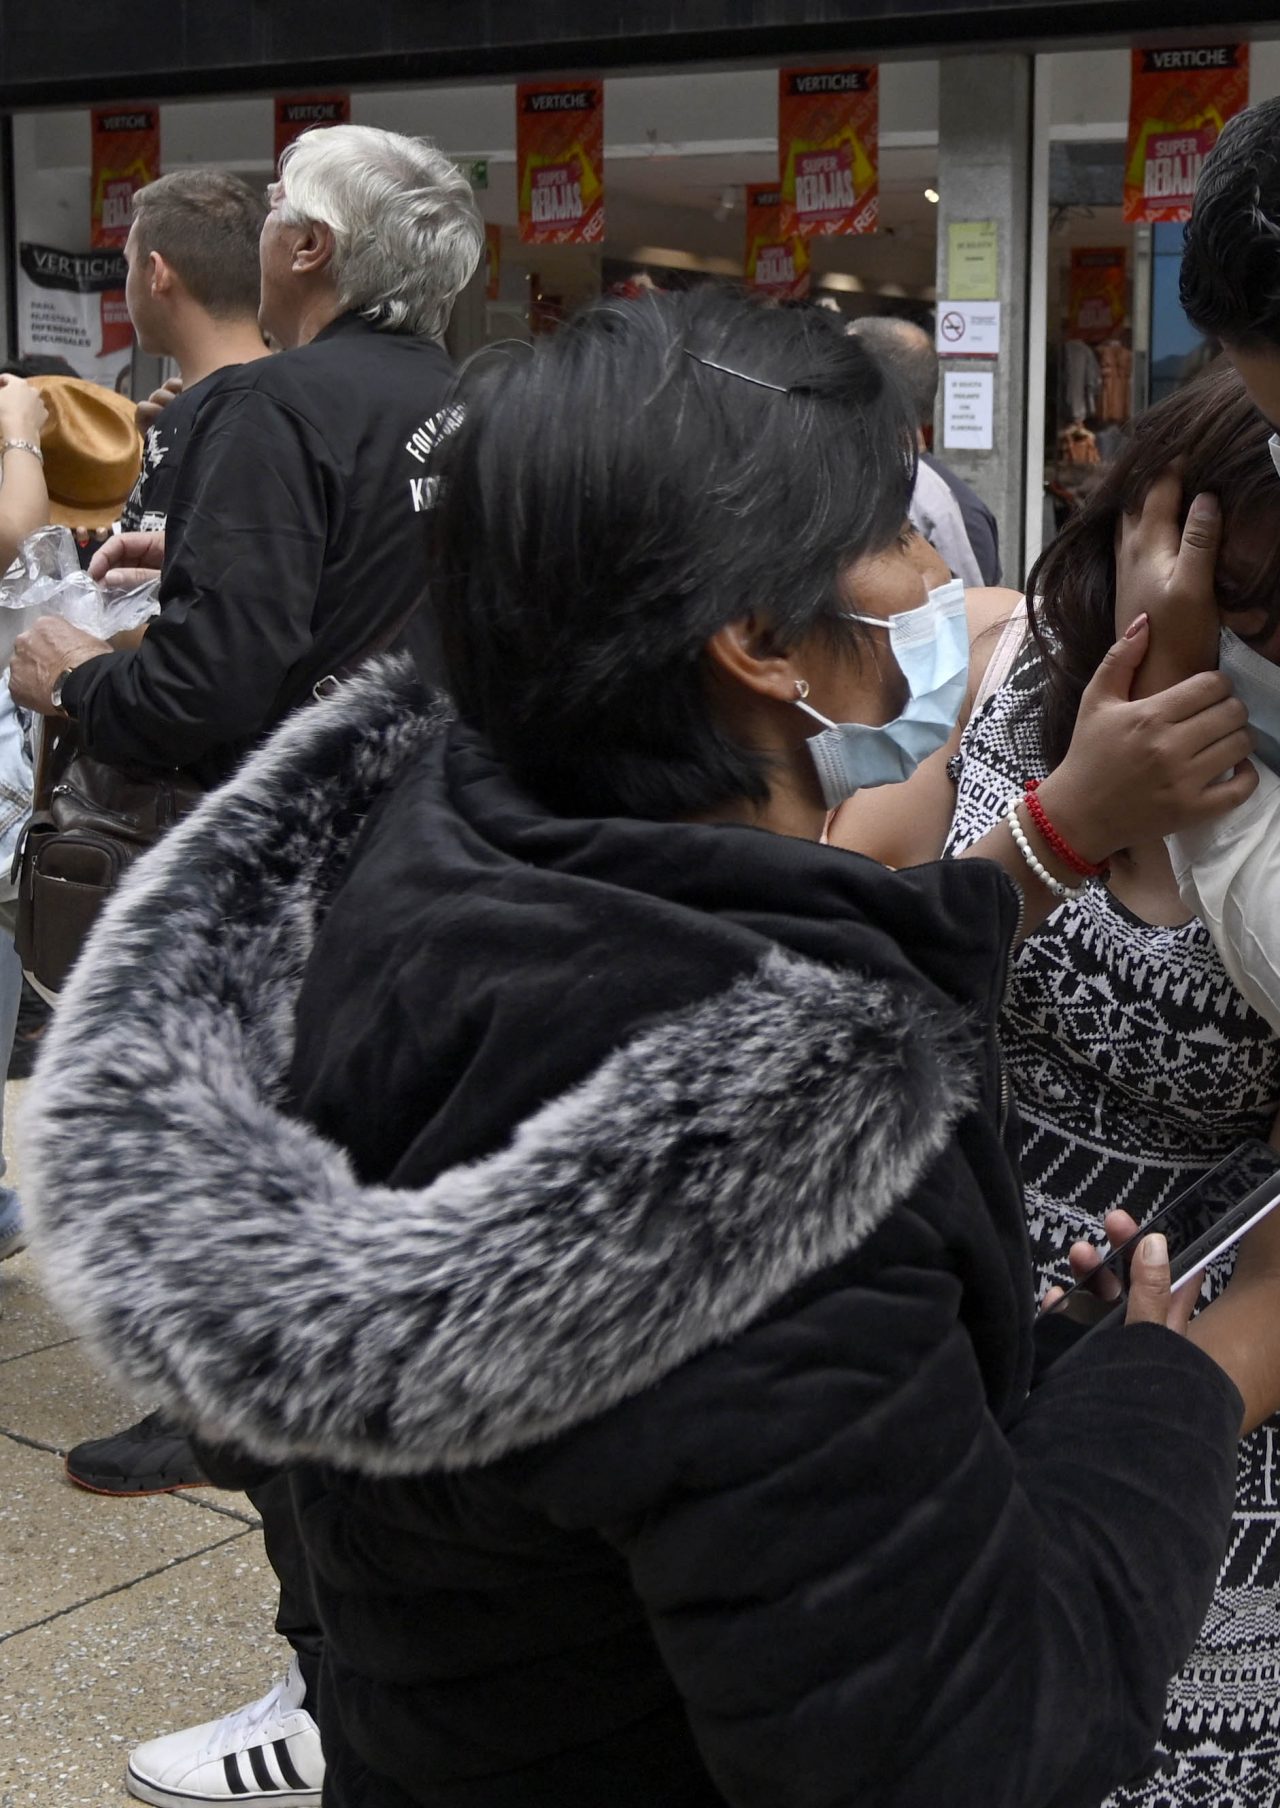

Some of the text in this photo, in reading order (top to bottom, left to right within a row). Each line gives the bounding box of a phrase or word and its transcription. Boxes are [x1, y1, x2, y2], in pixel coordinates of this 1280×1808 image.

[1153, 49, 1228, 68] VERTICHE
[795, 74, 860, 93] VERTICHE
[531, 92, 589, 111] VERTICHE
[1155, 138, 1198, 157] SUPER
[803, 156, 838, 175] SUPER
[795, 169, 855, 213] REBAJAS
[531, 182, 583, 223] REBAJAS
